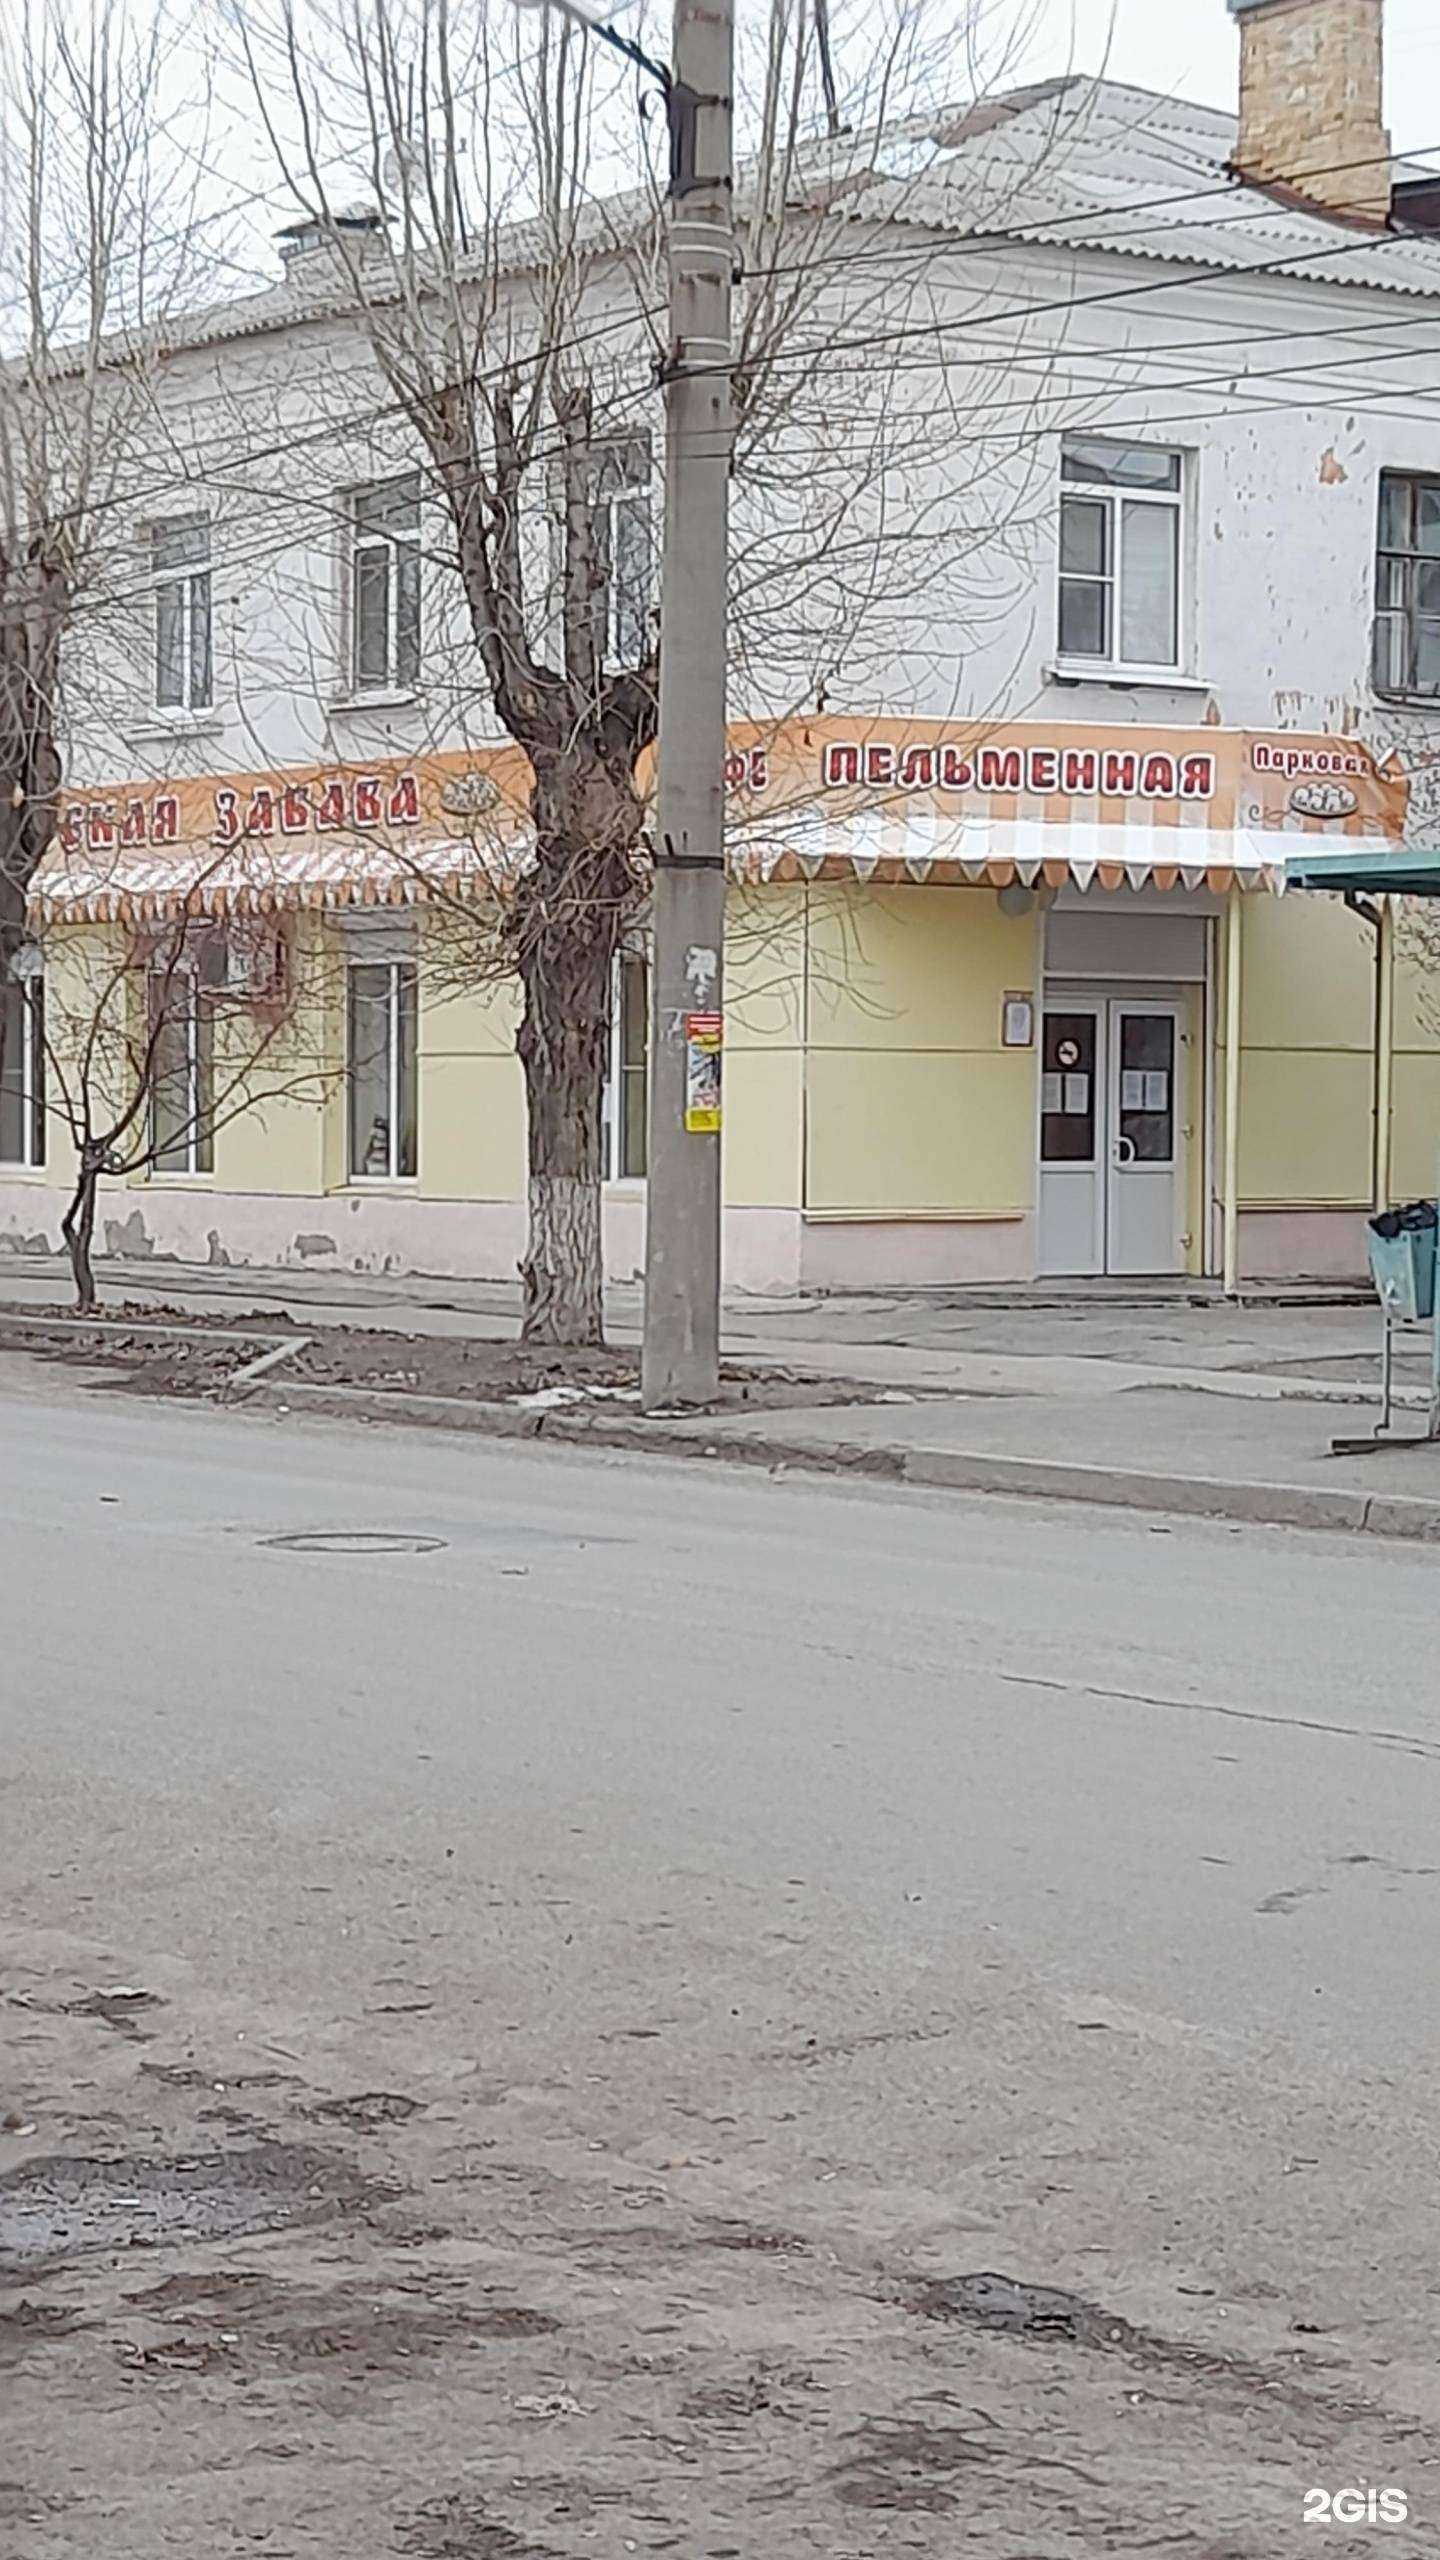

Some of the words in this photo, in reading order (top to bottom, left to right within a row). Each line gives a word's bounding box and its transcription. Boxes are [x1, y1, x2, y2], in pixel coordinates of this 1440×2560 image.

[724, 747, 769, 792] ФЕ
[824, 743, 1216, 799] ПЕЛЬМЕННАЯ
[60, 794, 179, 852] СКАЯ
[210, 770, 421, 846] ЗАБАВА
